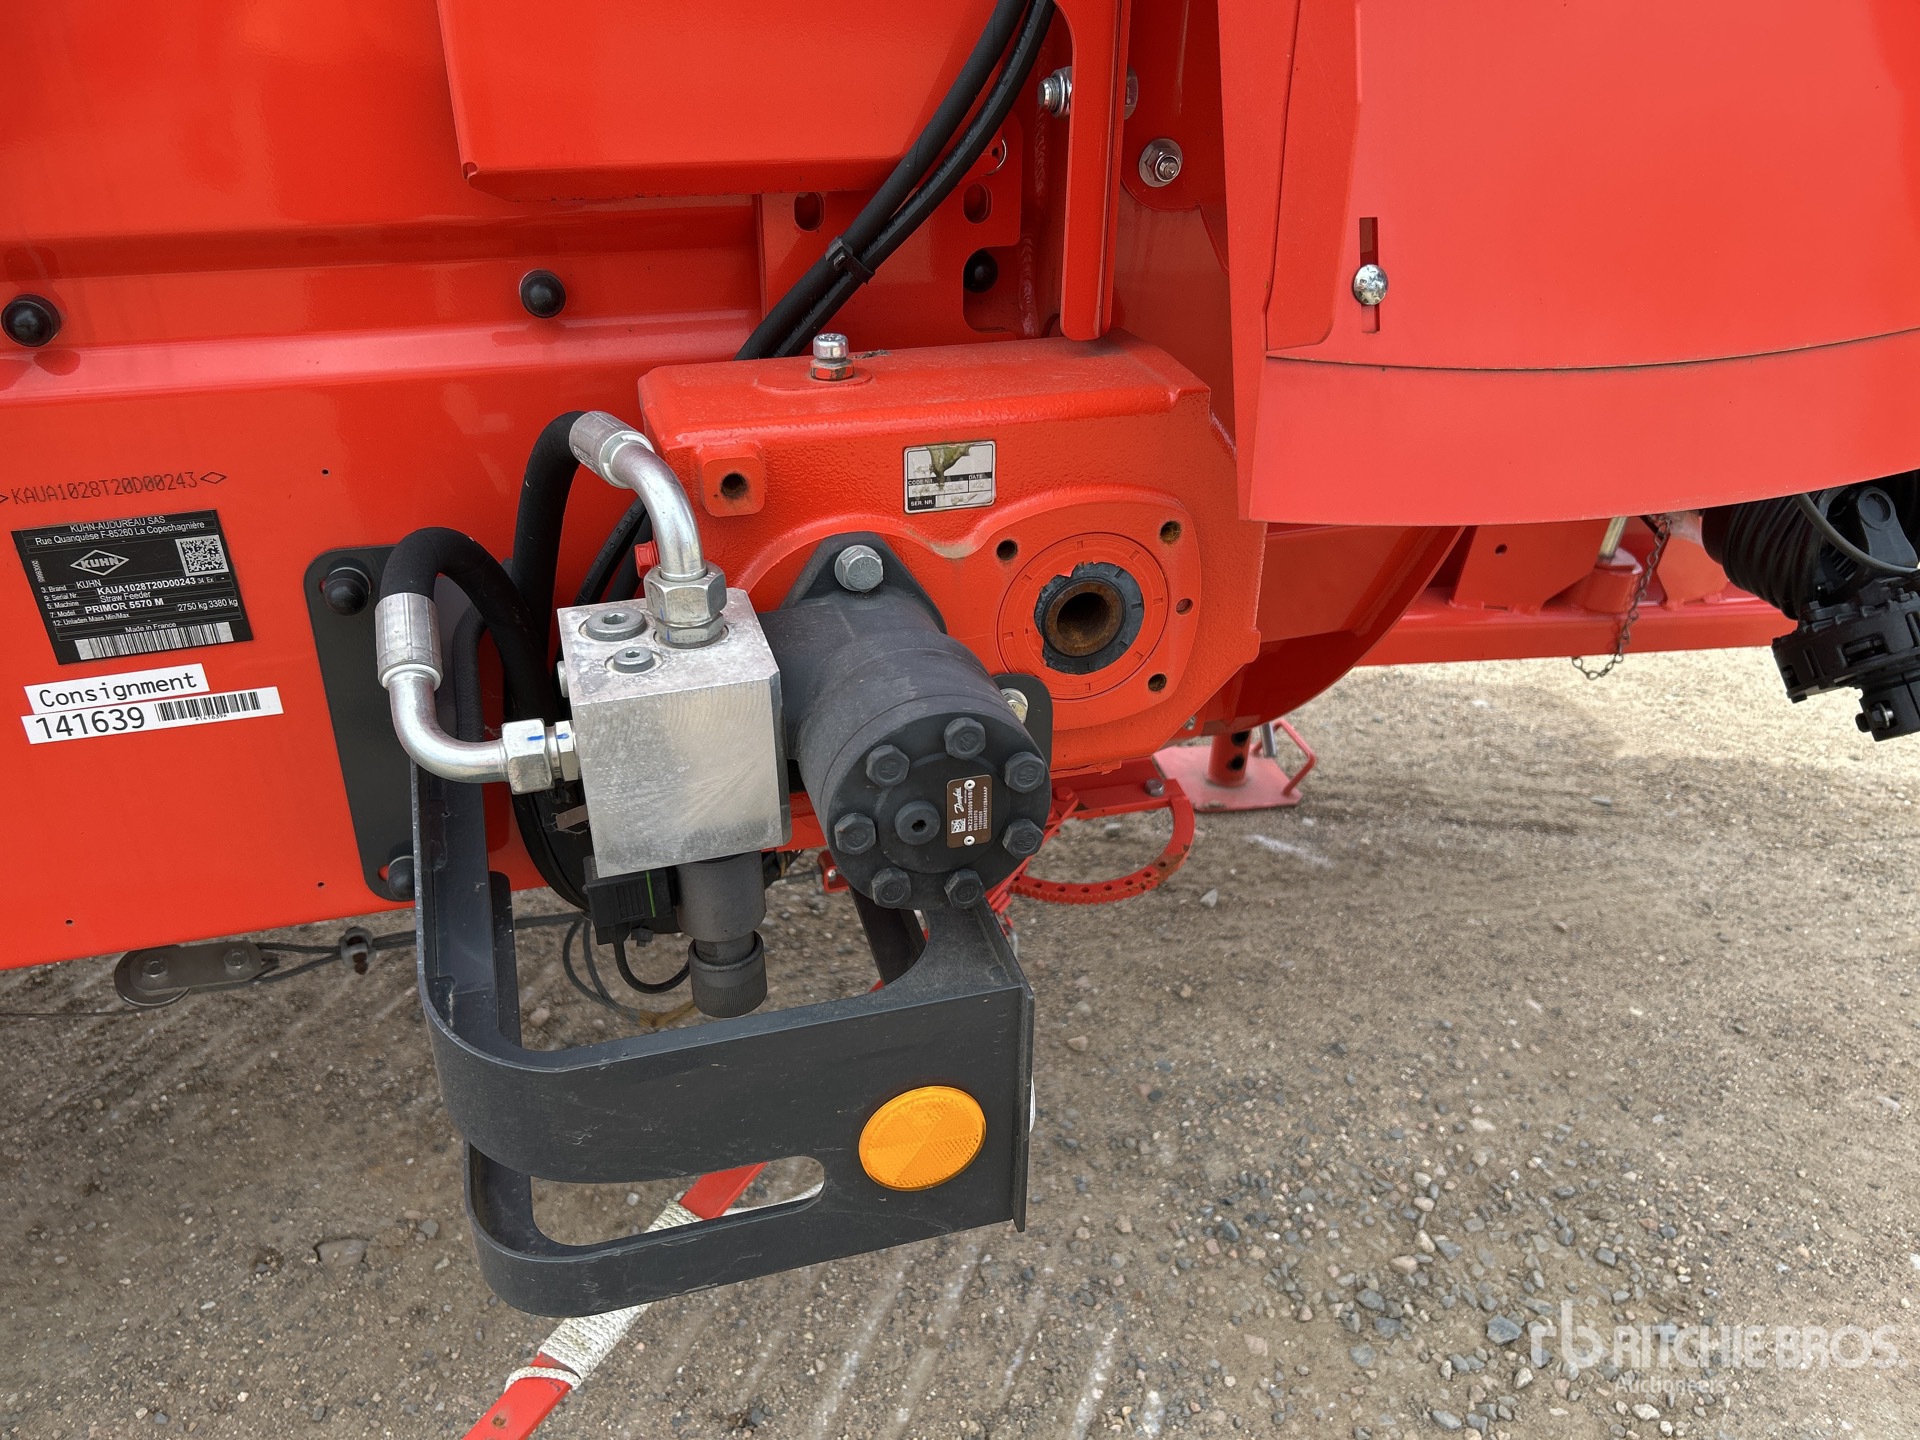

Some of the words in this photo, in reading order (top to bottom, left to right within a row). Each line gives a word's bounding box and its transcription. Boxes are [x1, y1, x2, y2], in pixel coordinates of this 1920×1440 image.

[11, 471, 198, 505] KAUA1028T20D00243
[35, 537, 53, 546] Rue
[100, 528, 133, 539] F-85260
[135, 526, 146, 536] La
[146, 521, 205, 535] Copechagnière
[70, 517, 146, 533] KUHN-AUDUREAU
[147, 515, 166, 526] SAS
[80, 556, 119, 570] KUHN
[48, 584, 67, 593] Brand
[76, 579, 102, 590] KUHN
[52, 592, 68, 601] Serial
[96, 577, 196, 595] KAUA1028T20D00243
[54, 600, 79, 609] Machine
[100, 593, 122, 603] Straw
[124, 590, 151, 601] Feeder
[57, 609, 76, 618] Model
[84, 602, 127, 614] PRIMOR
[129, 599, 153, 609] 5570
[154, 597, 164, 606] M
[88, 615, 105, 623] Mass
[177, 602, 197, 612] 2750
[198, 601, 208, 611] kg
[208, 599, 228, 608] 3380
[228, 598, 239, 607] kg
[125, 625, 145, 633] Made
[153, 621, 177, 630] France
[39, 672, 197, 708] Consignment
[36, 706, 145, 739] 141639
